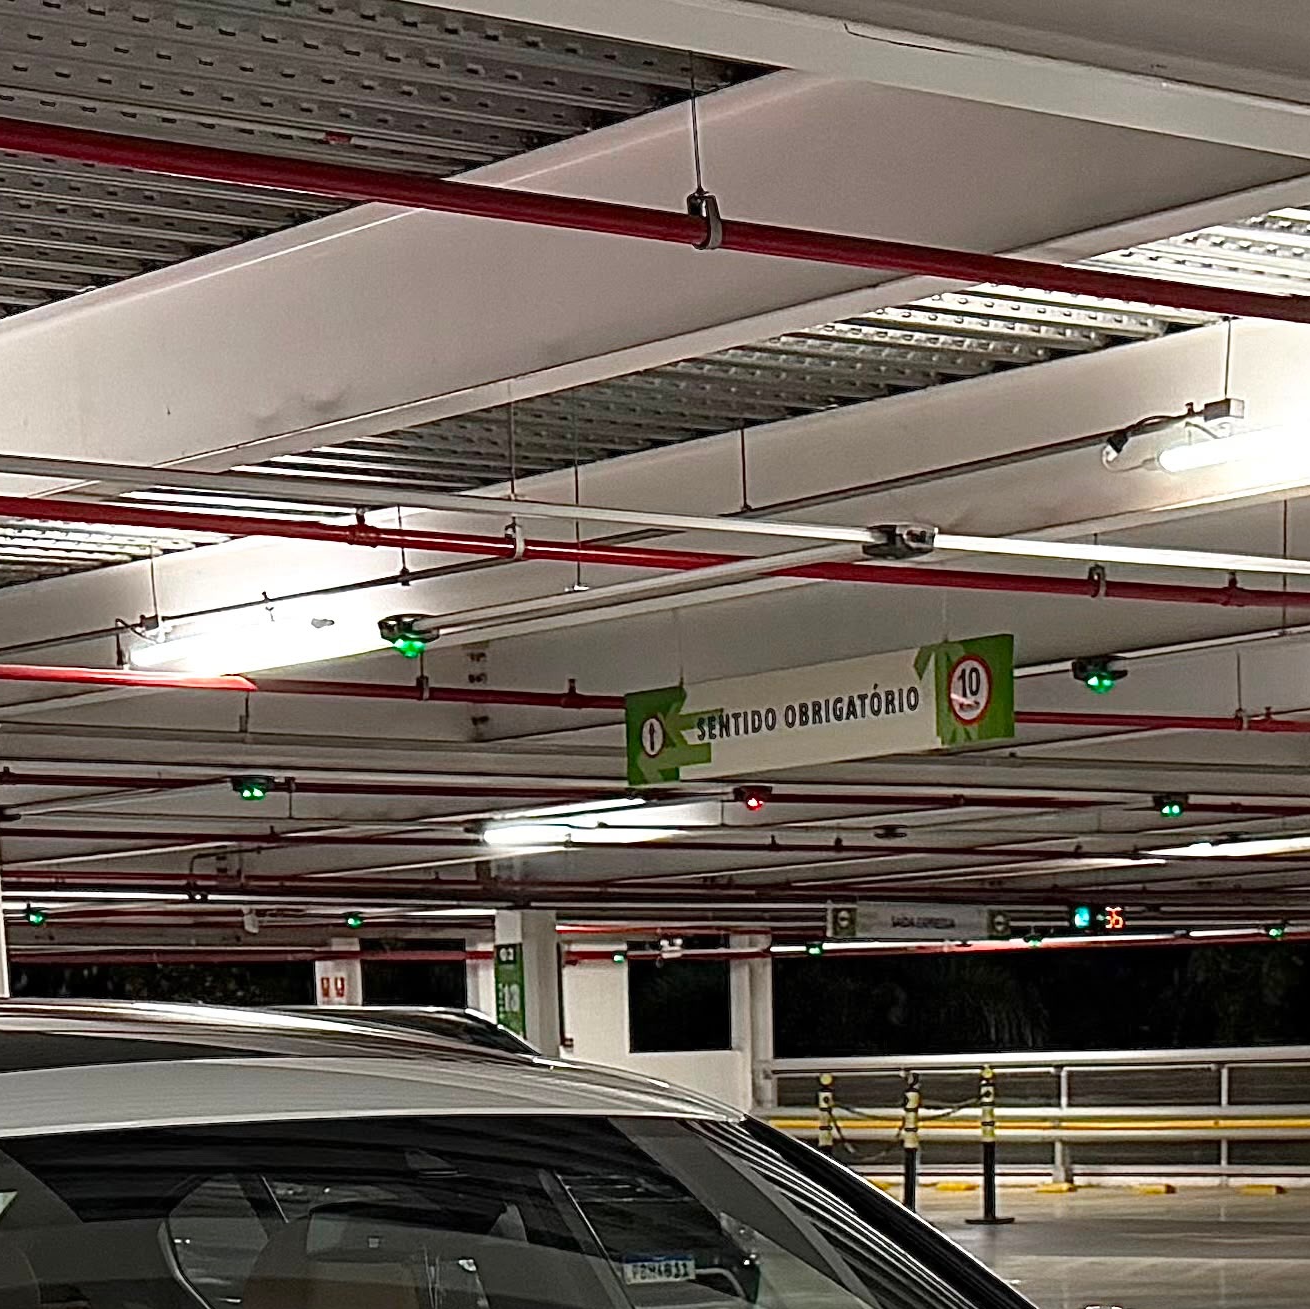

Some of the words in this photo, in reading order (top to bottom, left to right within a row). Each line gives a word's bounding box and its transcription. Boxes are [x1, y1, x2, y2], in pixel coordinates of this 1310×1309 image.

[957, 667, 981, 698] 10
[697, 706, 777, 742] SENTIDO
[785, 683, 920, 728] OBRIGATÓRIO
